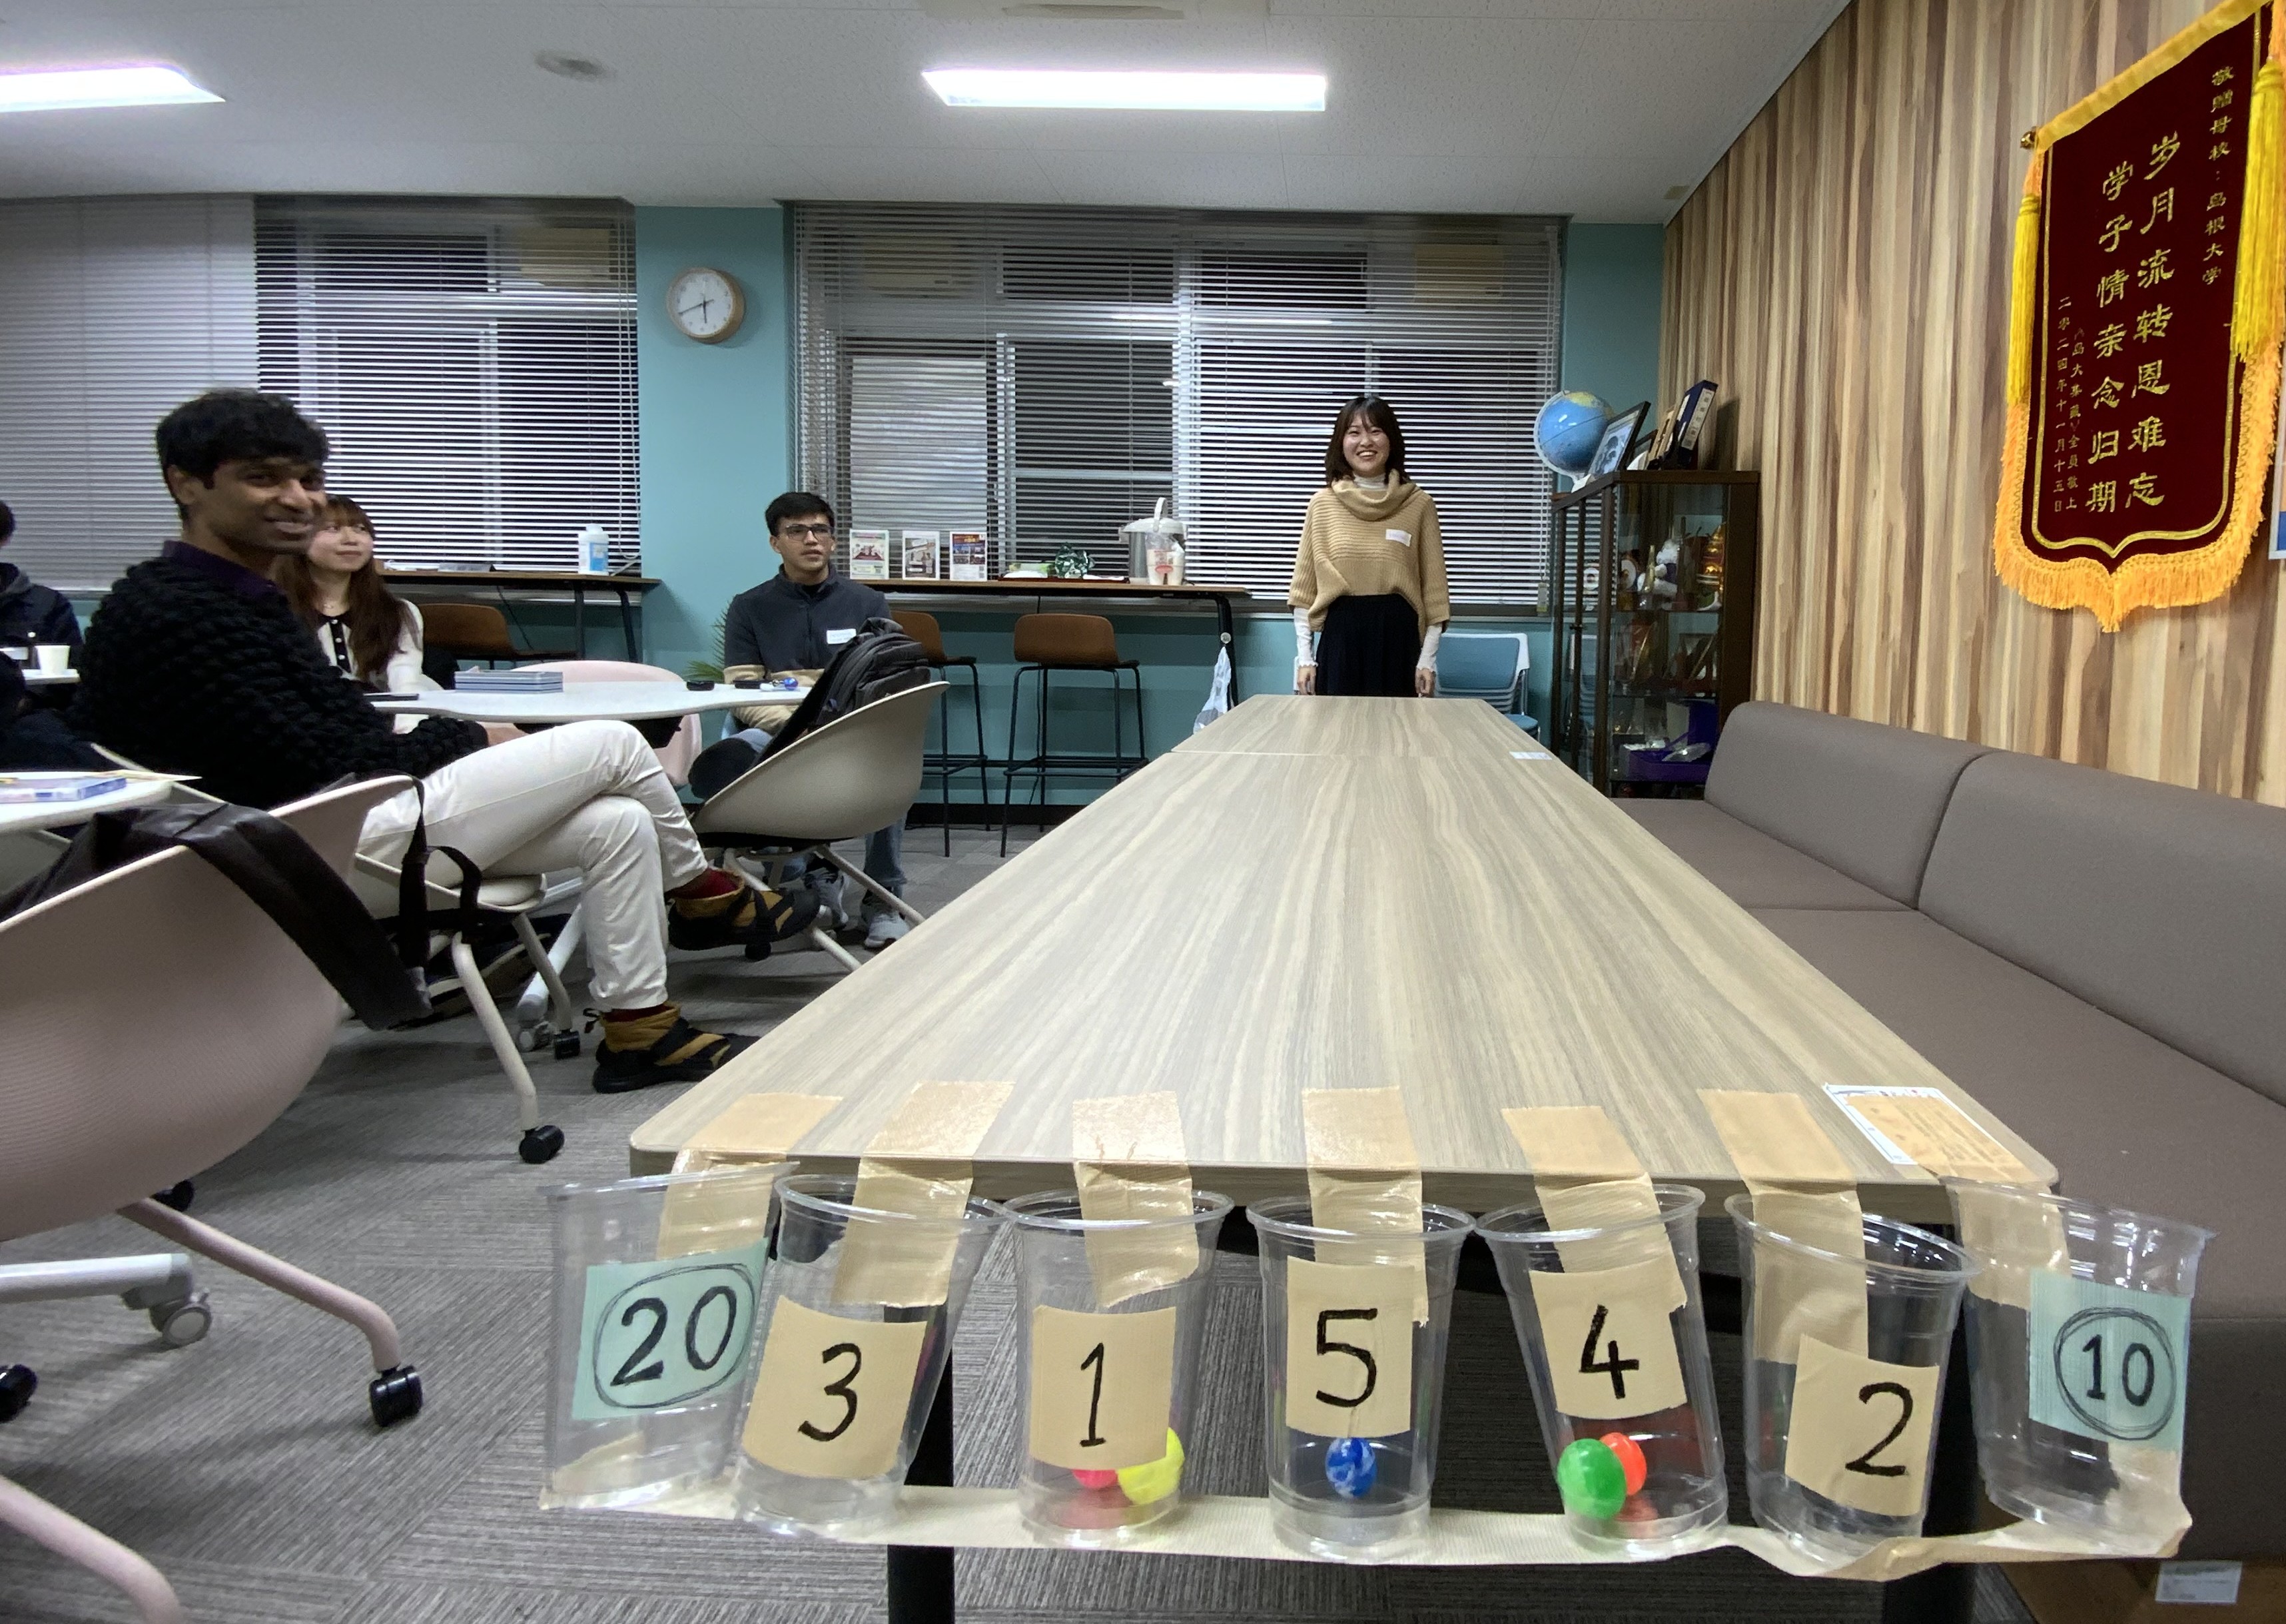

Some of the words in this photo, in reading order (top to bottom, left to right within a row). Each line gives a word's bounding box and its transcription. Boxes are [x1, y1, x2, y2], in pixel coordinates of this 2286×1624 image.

[2084, 160, 2133, 513] 学子情亲念归期
[2124, 131, 2181, 509] 岁月流转恩难忘
[610, 1285, 737, 1386] 20
[1315, 1307, 1378, 1408] 5
[1579, 1304, 1640, 1400] 4
[2081, 1333, 2155, 1408] 10
[797, 1342, 862, 1442] 3
[1079, 1342, 1106, 1447] 1
[1844, 1381, 1914, 1477] 2
